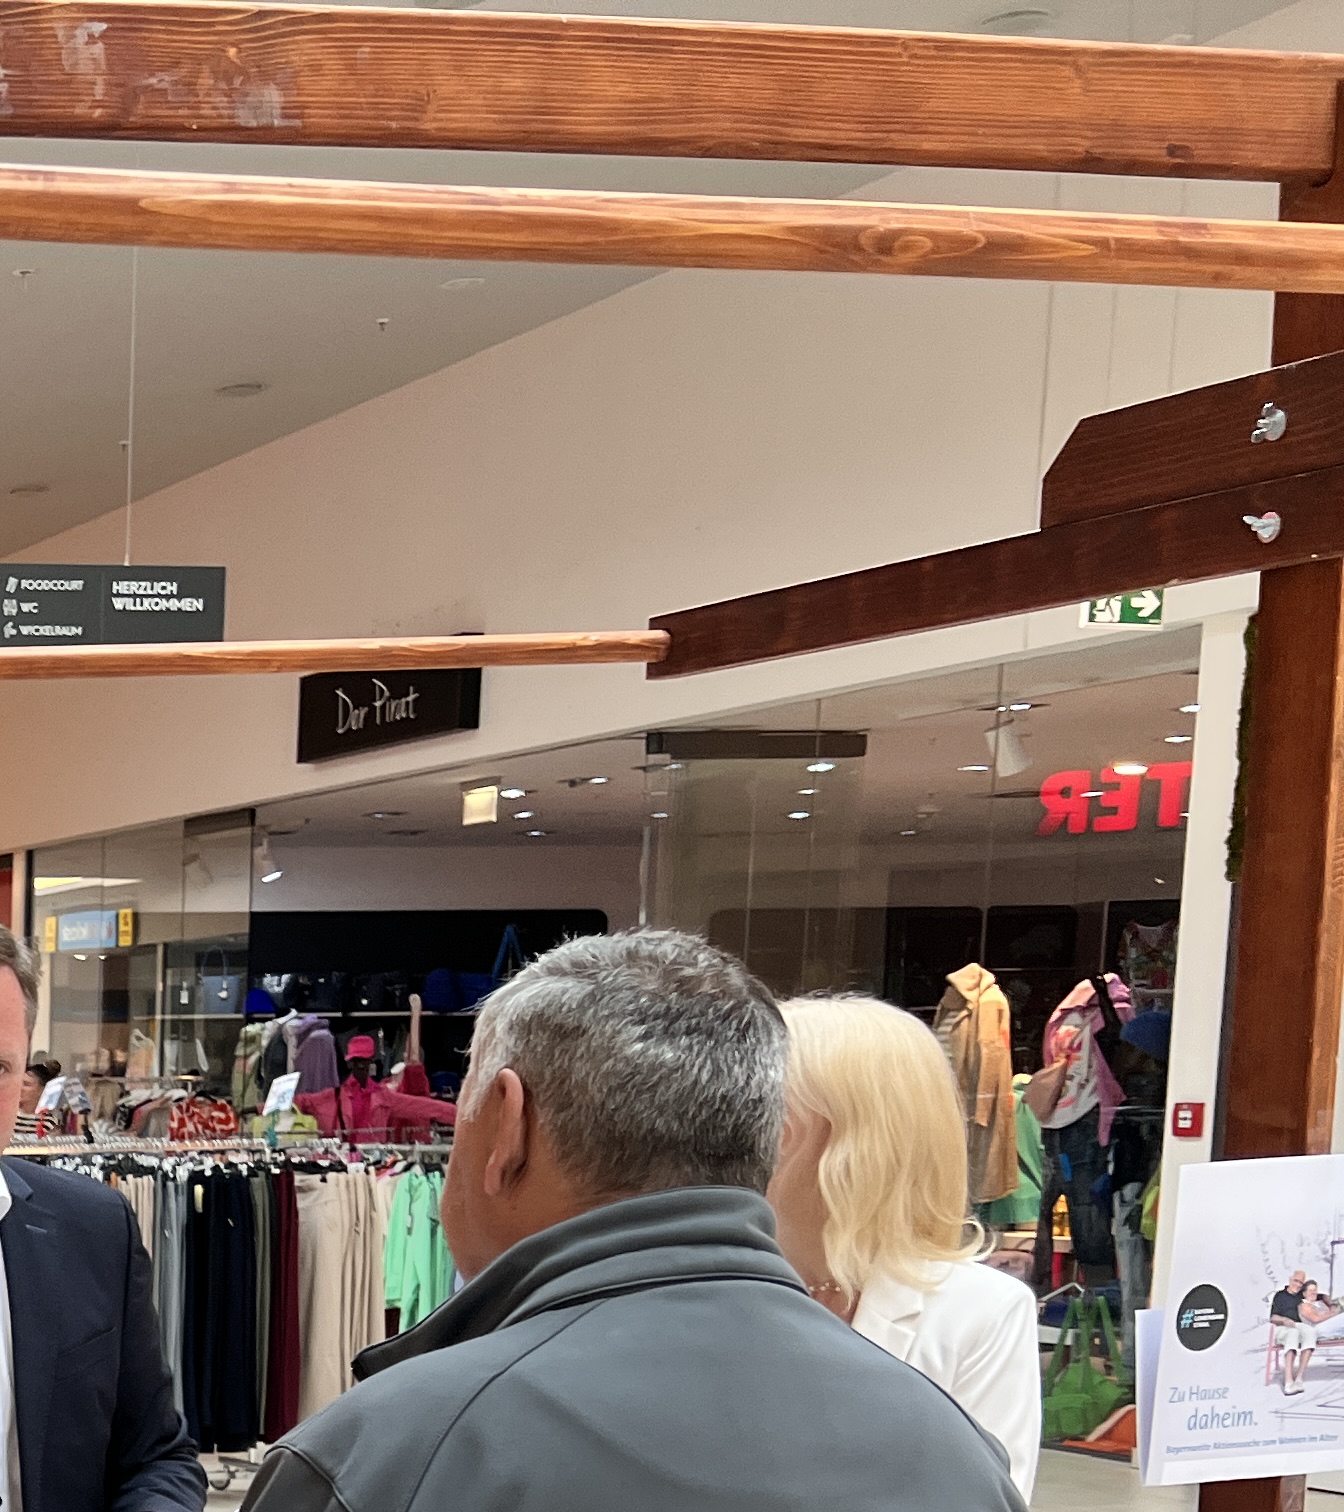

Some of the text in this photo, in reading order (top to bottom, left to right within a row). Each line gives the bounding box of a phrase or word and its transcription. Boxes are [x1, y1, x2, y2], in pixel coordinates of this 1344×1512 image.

[20, 580, 85, 591] FOODCOURT
[112, 581, 178, 595] HERZLICH
[19, 602, 39, 613] WC
[112, 598, 204, 612] WILLKOMMEN
[334, 676, 420, 735] Der Pirat
[1168, 1384, 1230, 1404] Zu Hause
[1187, 1405, 1259, 1431] daheim.
